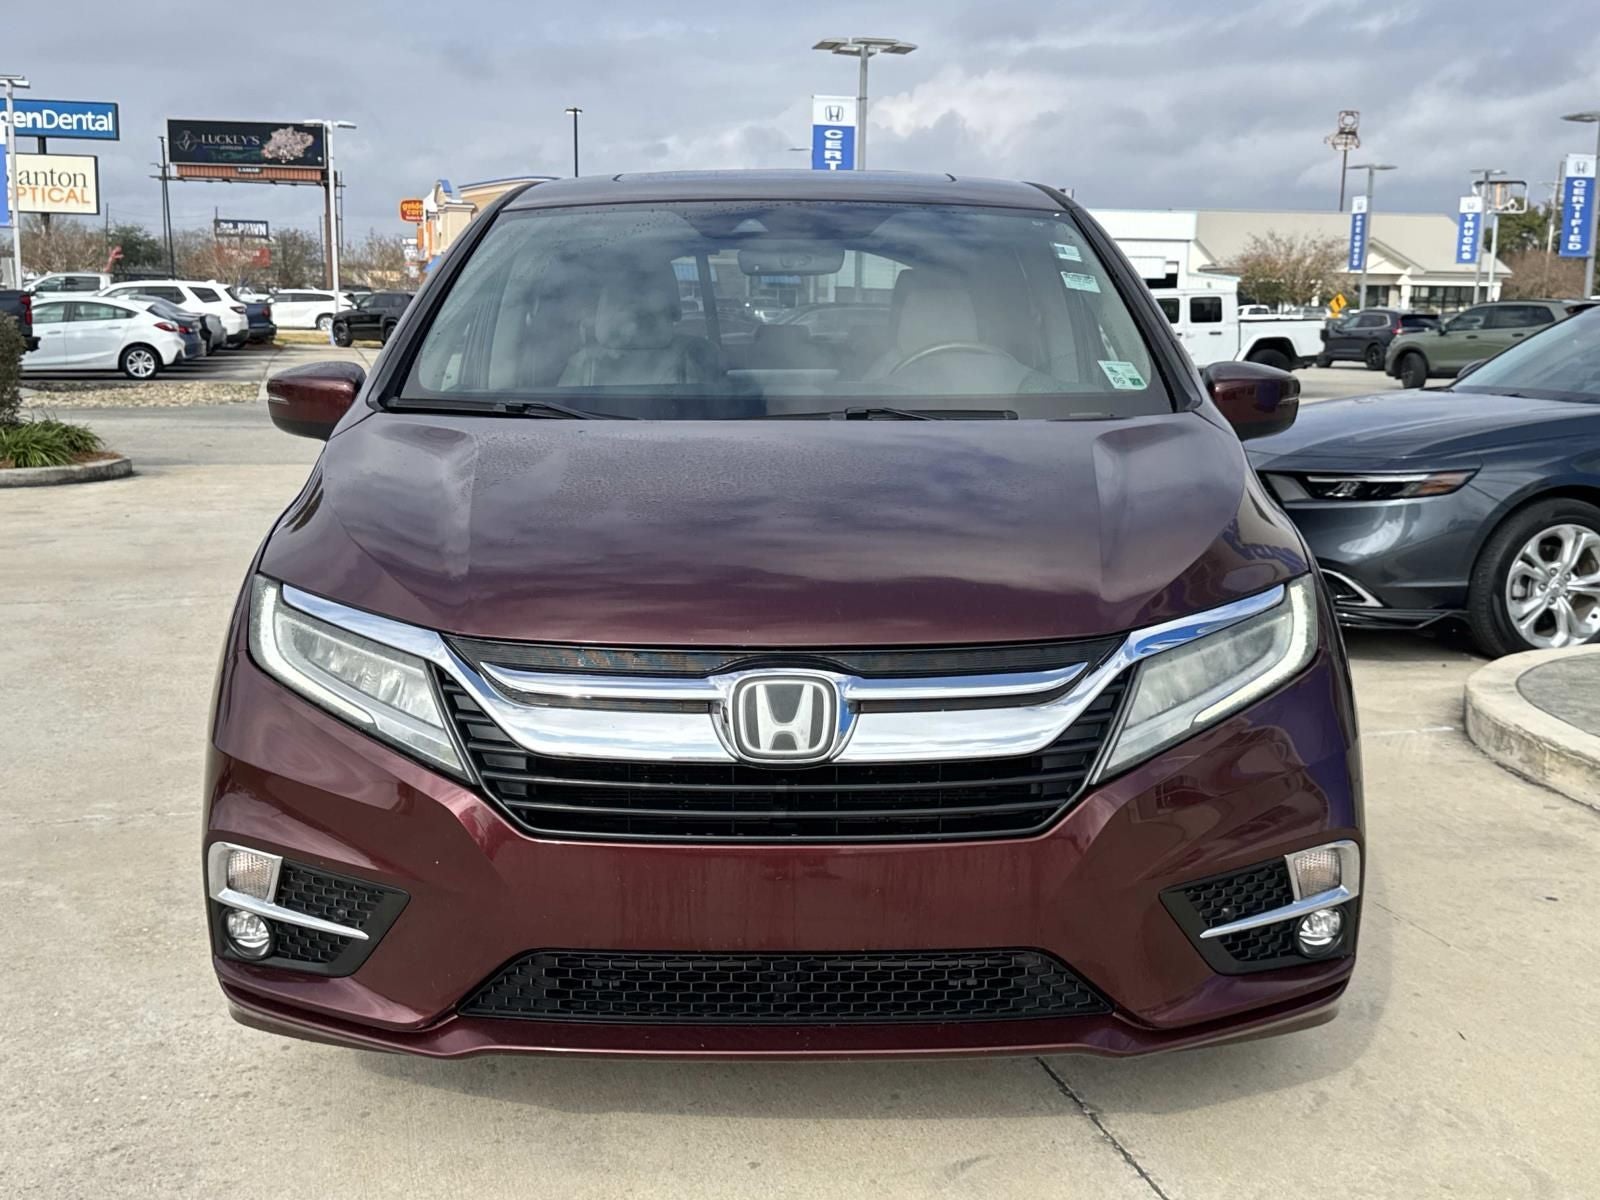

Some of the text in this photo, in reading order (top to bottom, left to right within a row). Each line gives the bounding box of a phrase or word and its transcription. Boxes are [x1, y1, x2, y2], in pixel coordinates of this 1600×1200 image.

[8, 168, 87, 188] anton
[8, 186, 90, 204] PTICAL
[1567, 180, 1587, 250] CERTIFIED
[1461, 214, 1475, 260] TRUCKS
